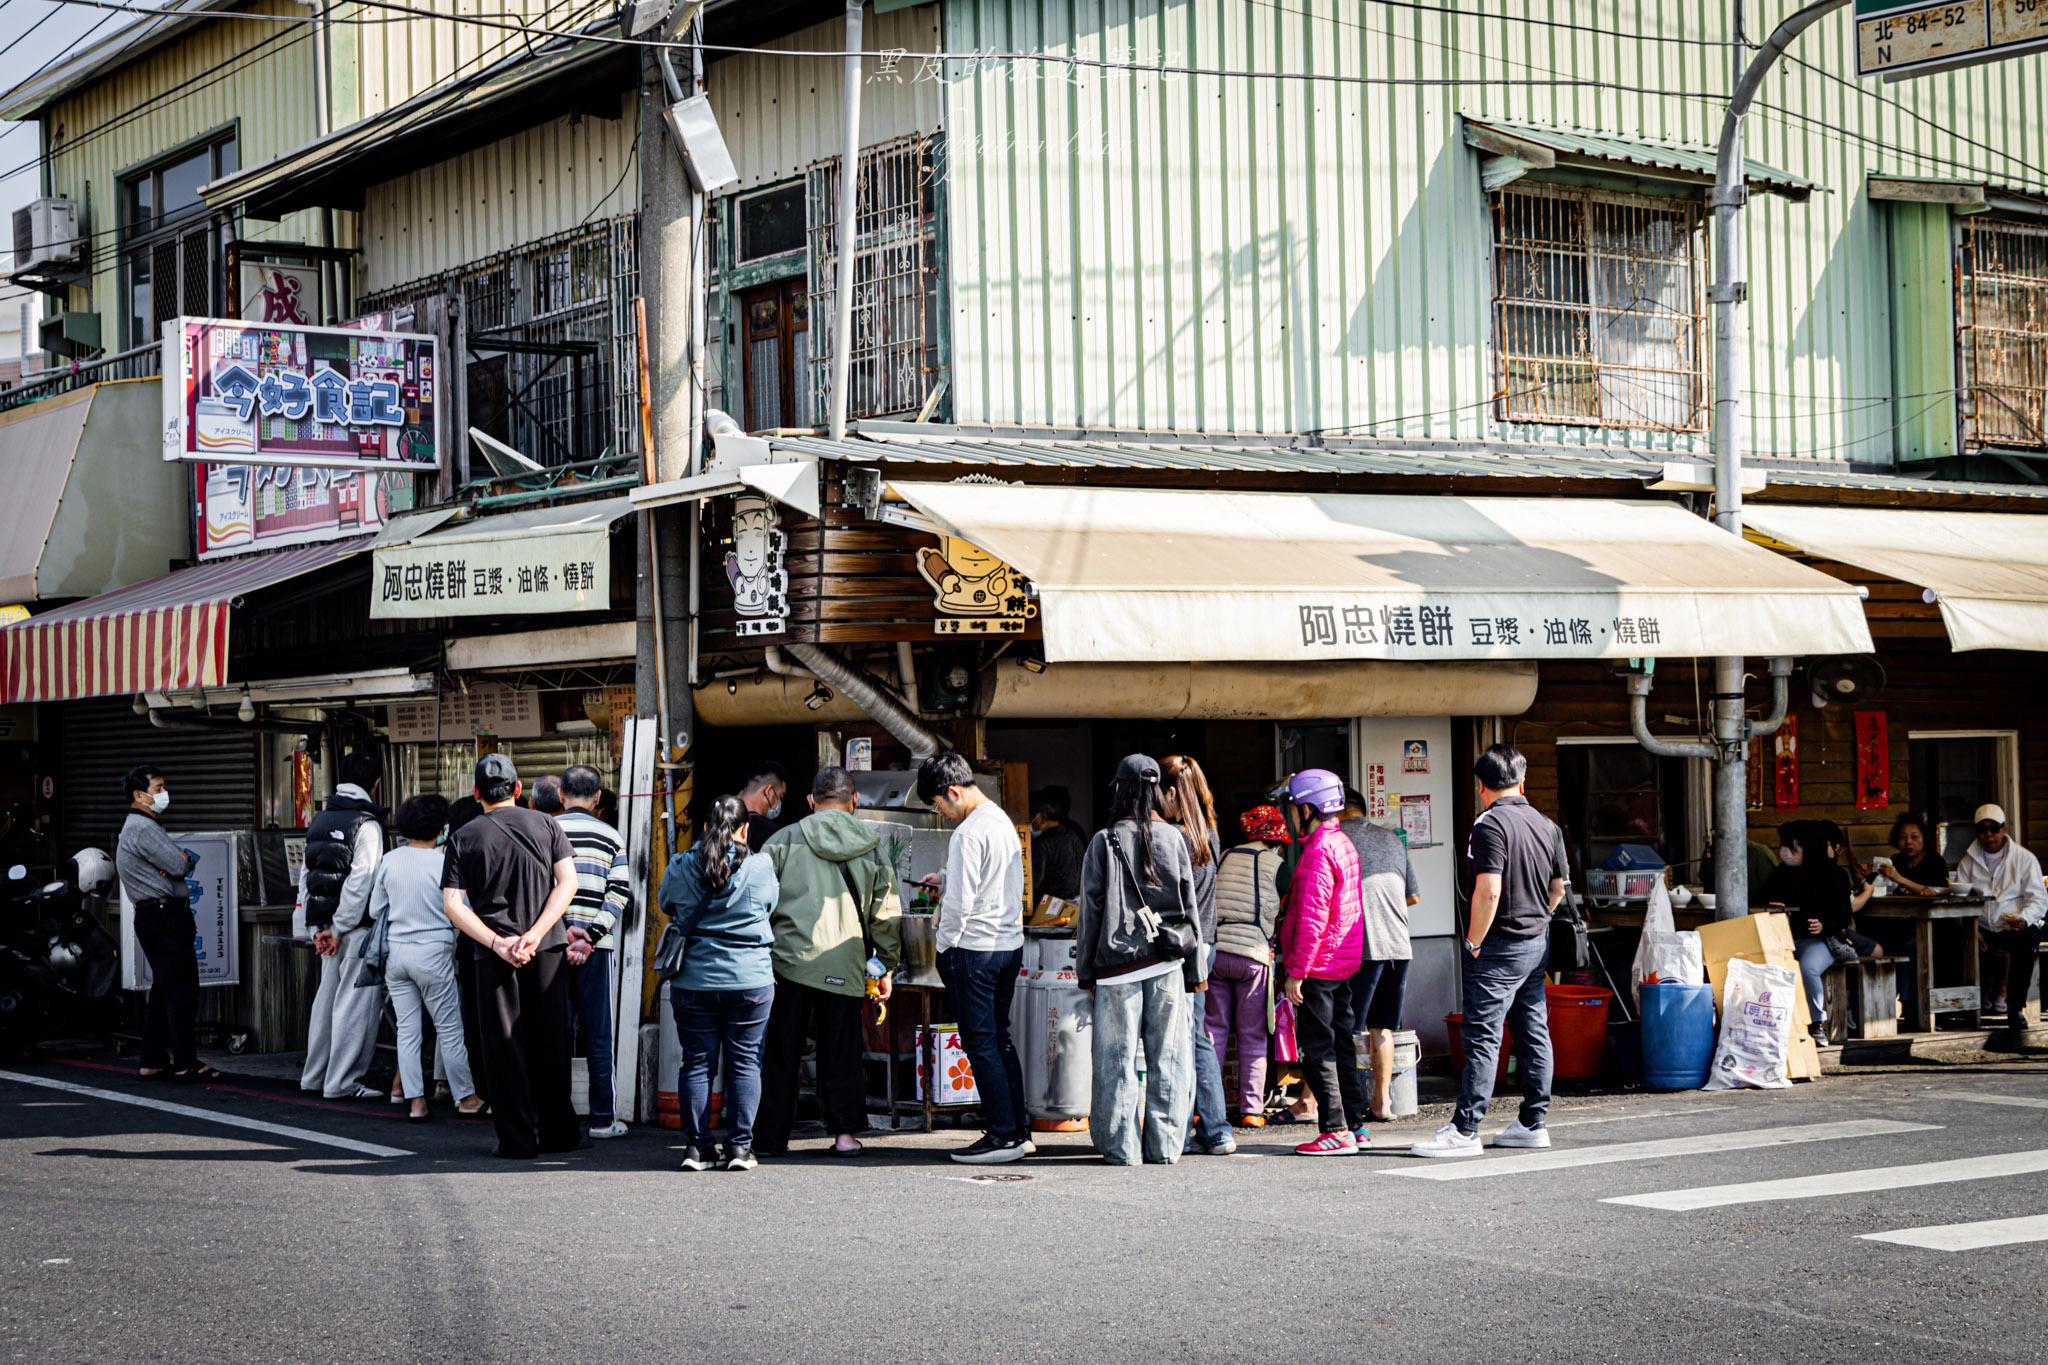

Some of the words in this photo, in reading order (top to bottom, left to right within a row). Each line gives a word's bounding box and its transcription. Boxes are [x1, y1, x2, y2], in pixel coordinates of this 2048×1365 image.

[1875, 21, 1893, 42] 北
[1907, 6, 1965, 34] 84-52
[1878, 46, 1892, 64] N
[262, 271, 309, 326] 成
[214, 363, 405, 425] 今好食記
[214, 427, 252, 436] アイスクリーム
[383, 560, 467, 602] 阿忠燒餅
[1299, 604, 1453, 646] 阿忠燒餅
